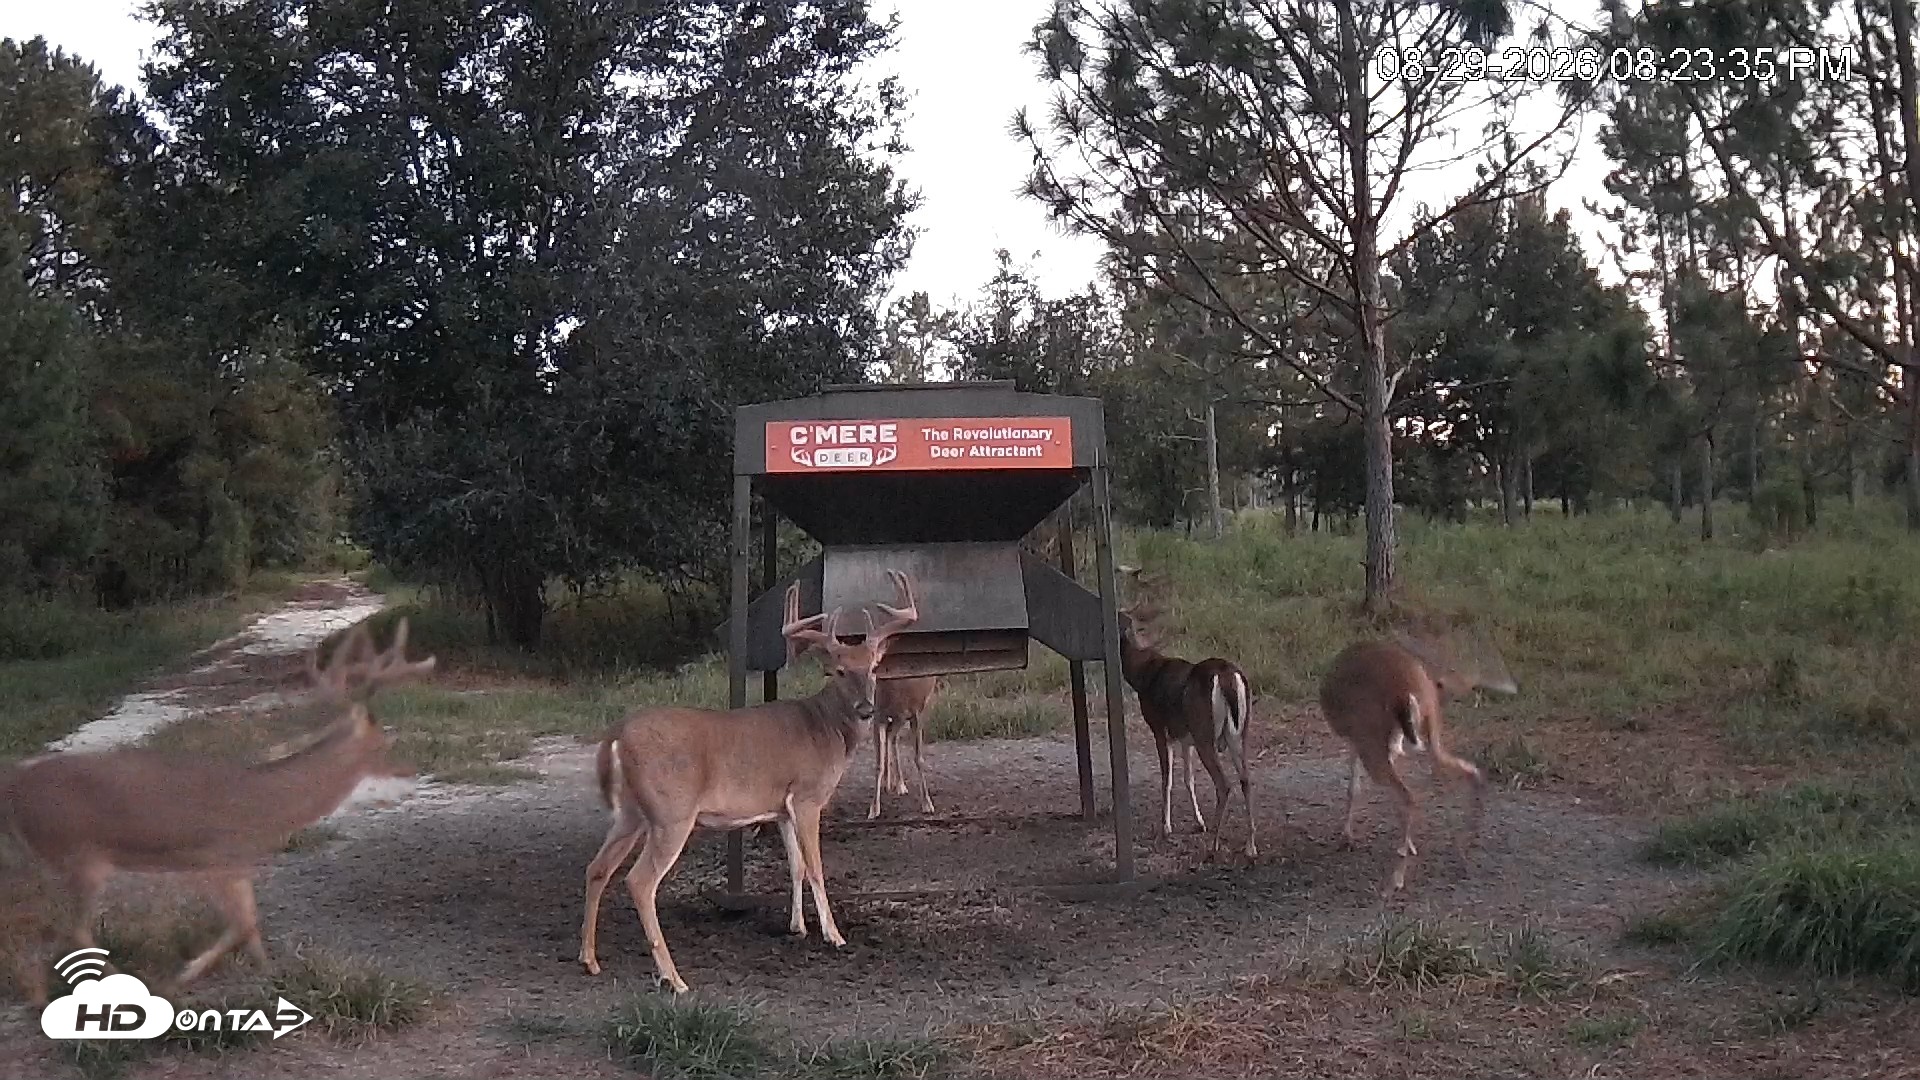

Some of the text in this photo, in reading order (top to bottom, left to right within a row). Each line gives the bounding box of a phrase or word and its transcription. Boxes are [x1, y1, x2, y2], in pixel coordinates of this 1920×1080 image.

[790, 423, 897, 445] C'MERE
[921, 427, 1053, 441] The Revolutionary
[819, 452, 869, 463] DEER
[930, 444, 1043, 458] Deer Attractant
